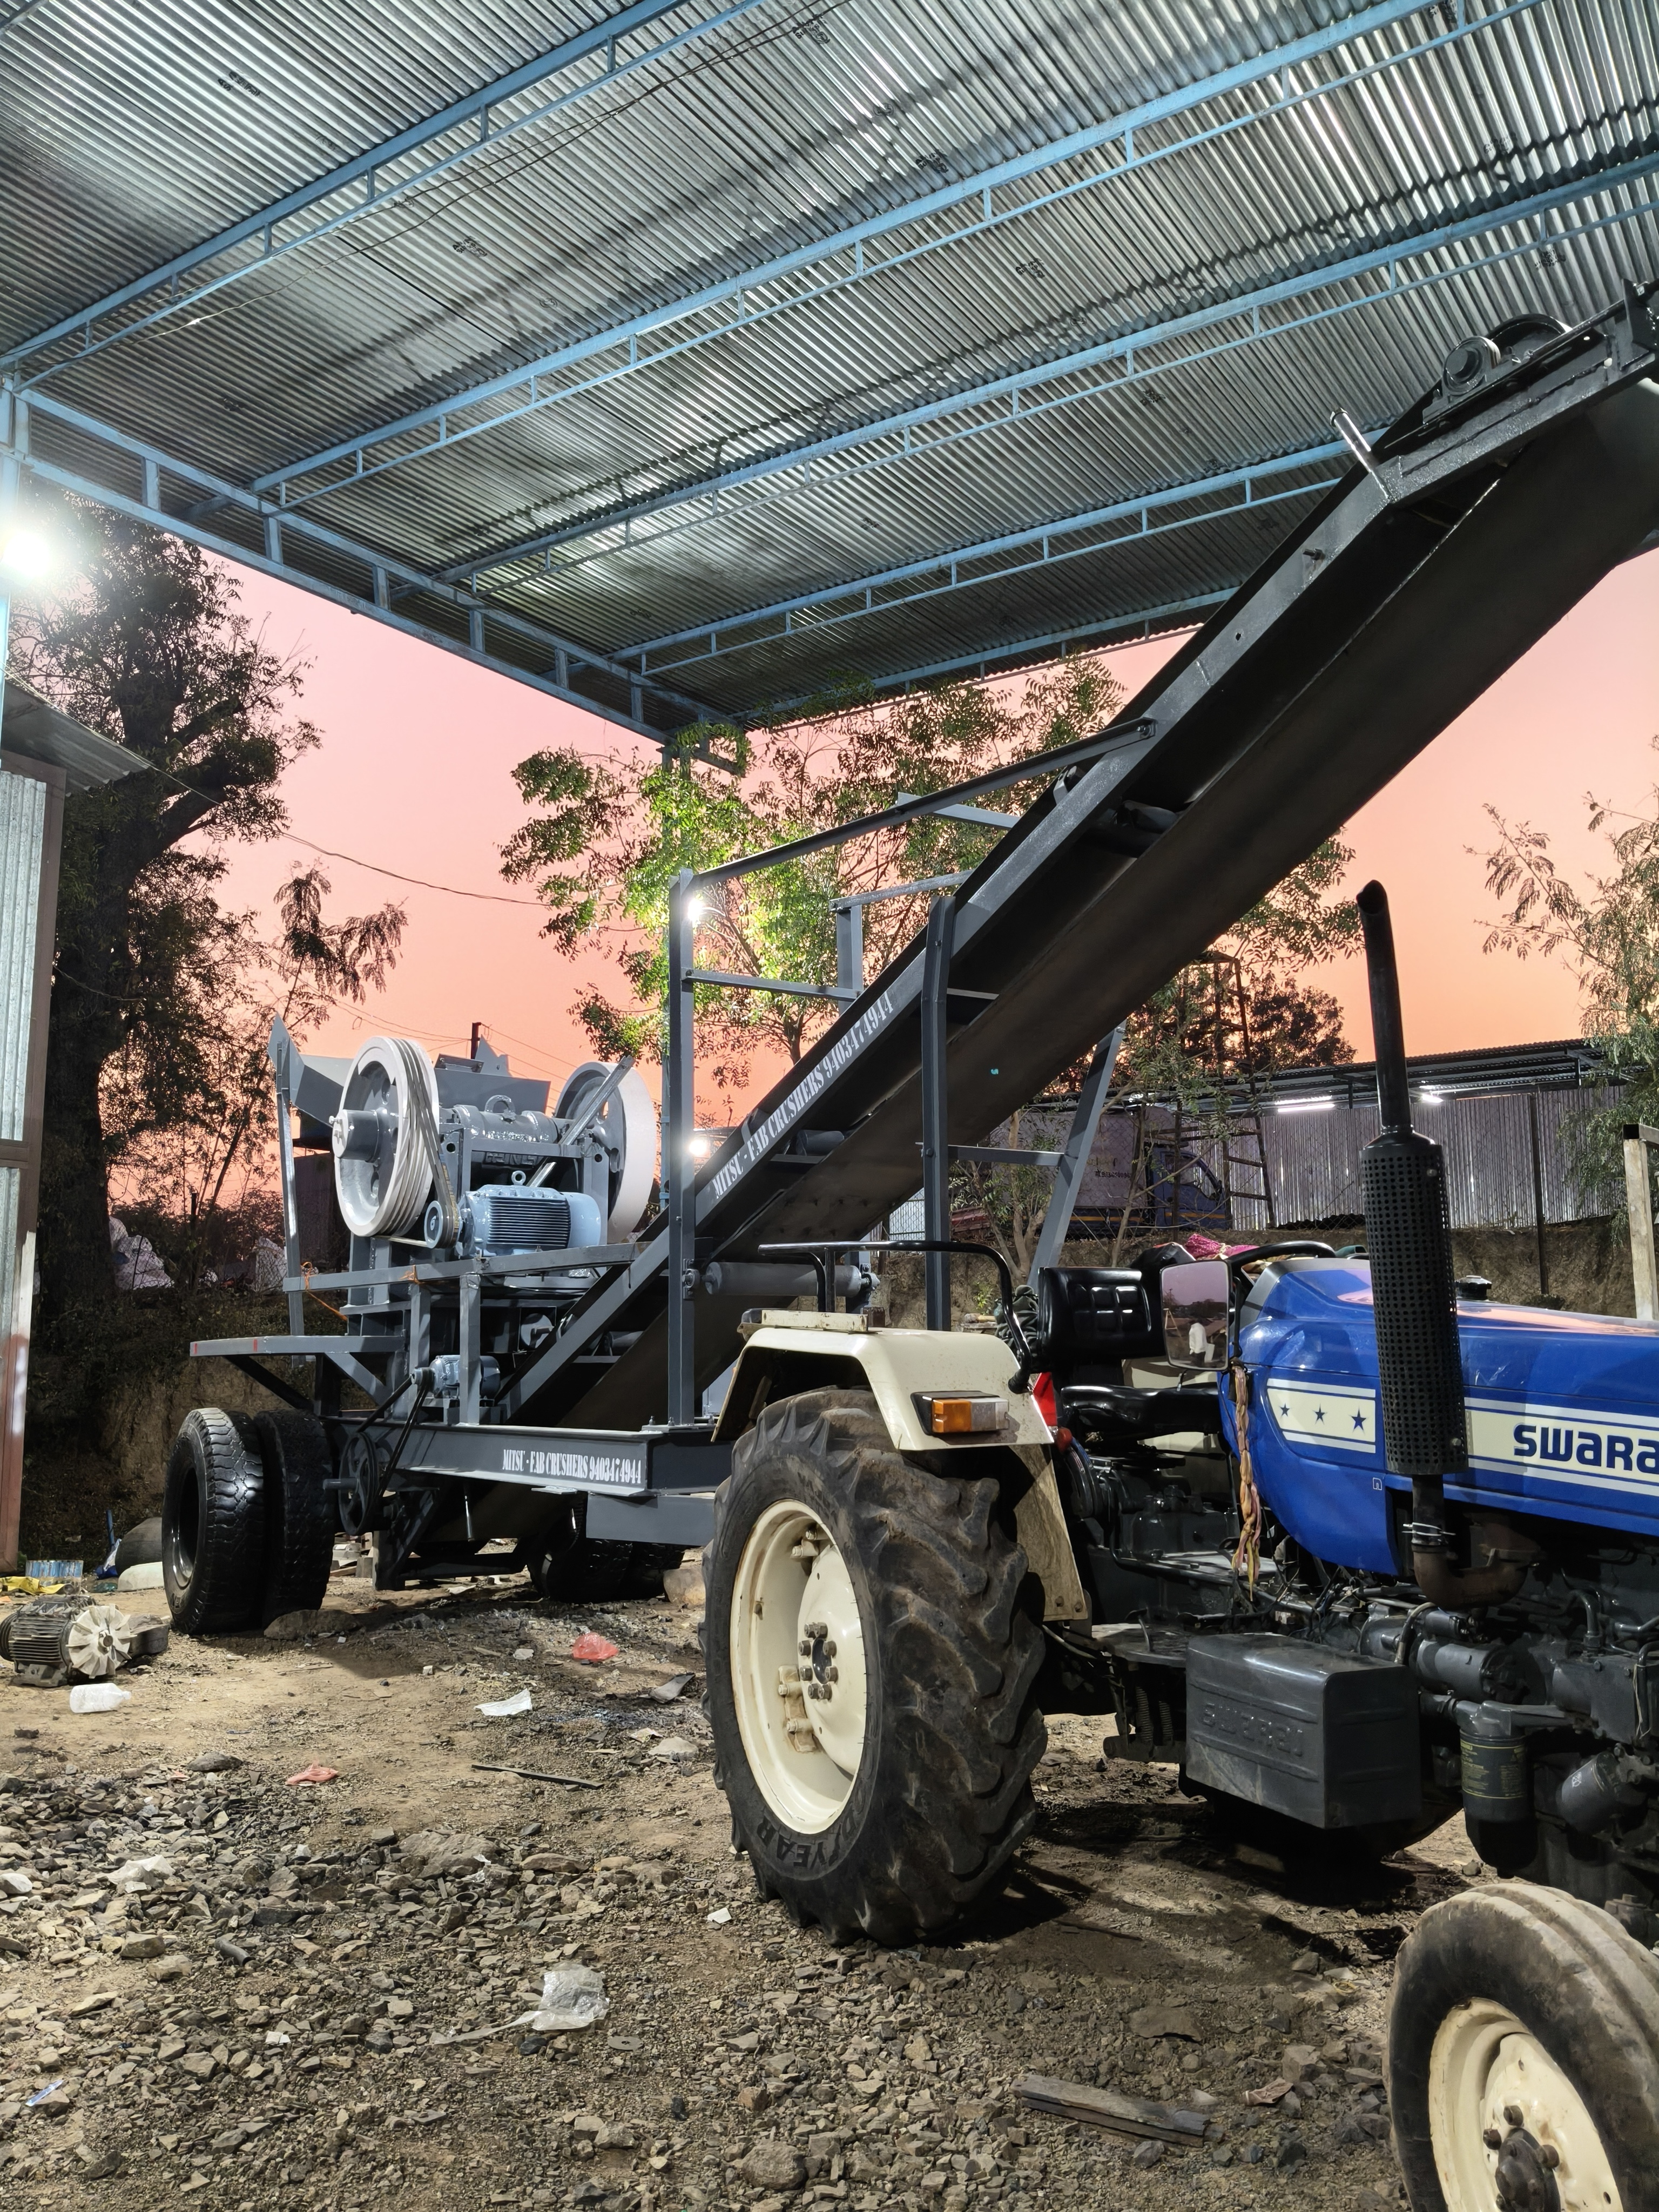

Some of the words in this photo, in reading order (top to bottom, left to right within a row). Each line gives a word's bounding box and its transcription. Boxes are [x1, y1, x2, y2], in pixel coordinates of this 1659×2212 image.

[712, 1151, 744, 1199] MITSU
[747, 1125, 769, 1162] FAB
[767, 1065, 824, 1138] CRUSHERS
[822, 990, 894, 1078] 9403474944
[502, 1449, 525, 1472] MITSU
[530, 1451, 545, 1474] FAB
[545, 1452, 588, 1479] CRUSHERS
[589, 1456, 641, 1483] 9403474944
